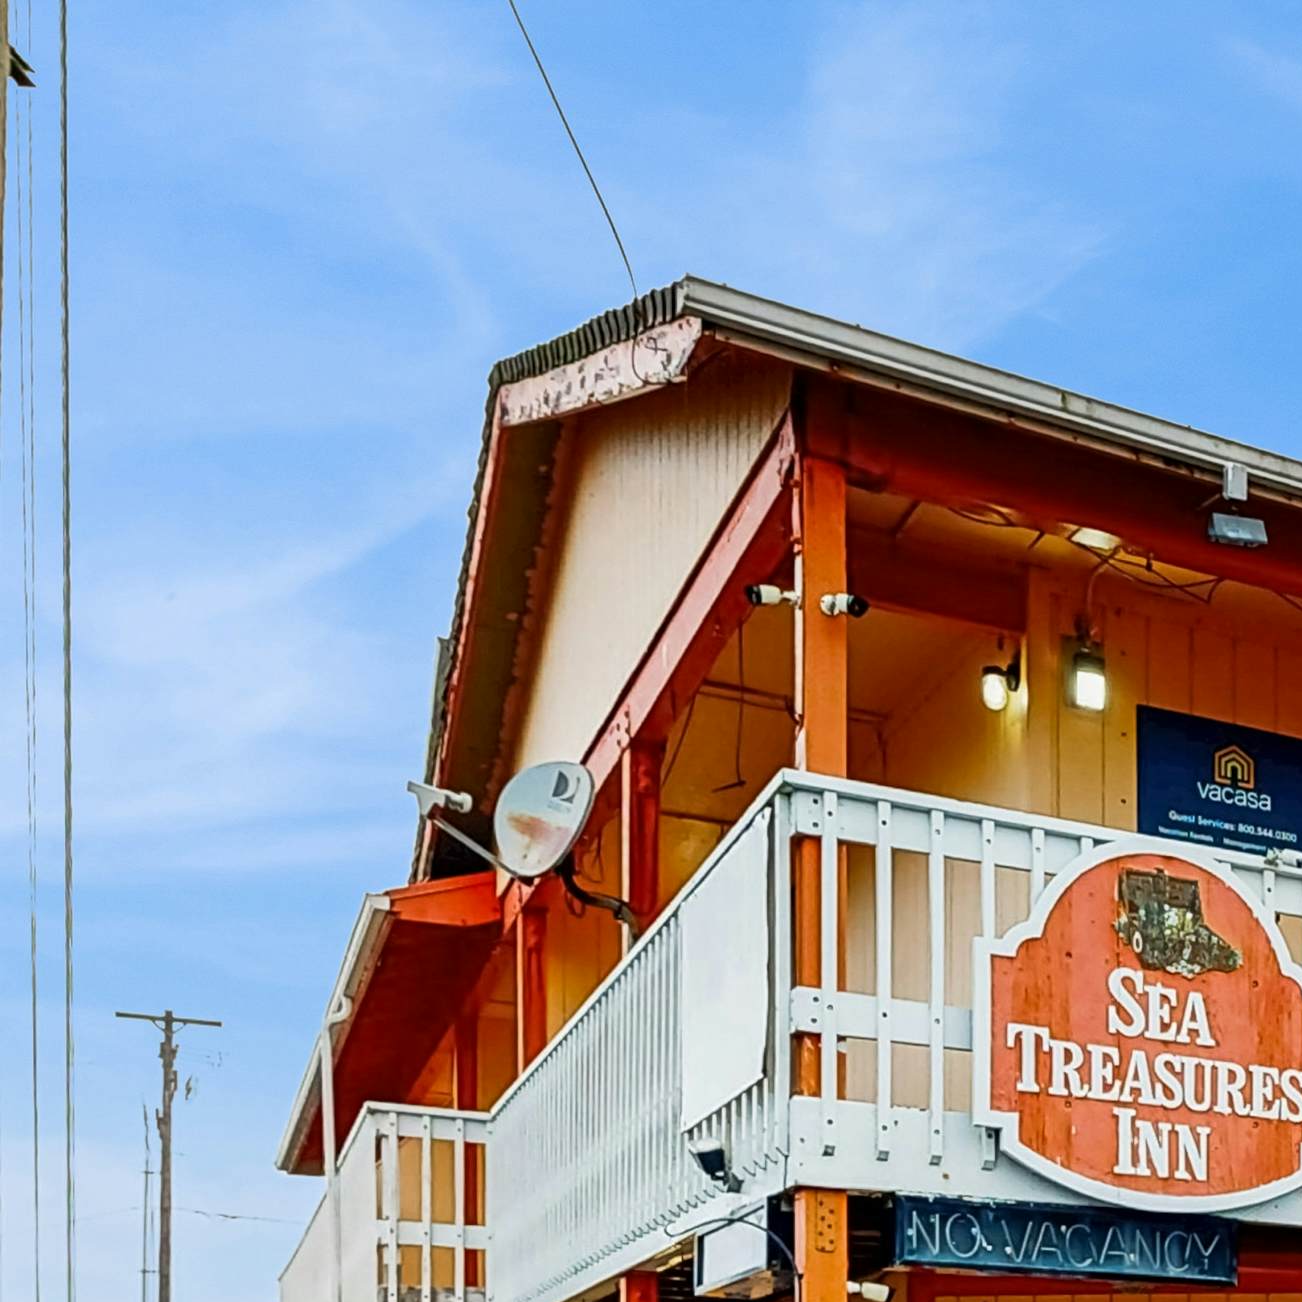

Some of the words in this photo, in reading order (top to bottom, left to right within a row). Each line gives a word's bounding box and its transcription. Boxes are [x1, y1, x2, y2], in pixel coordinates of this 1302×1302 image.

[1168, 810, 1196, 823] Guest
[1197, 781, 1272, 812] vacasa
[1107, 967, 1216, 1048] SEA
[1112, 1107, 1211, 1183] INN
[911, 1210, 982, 1258] NO
[1001, 1219, 1220, 1273] VACANCY
